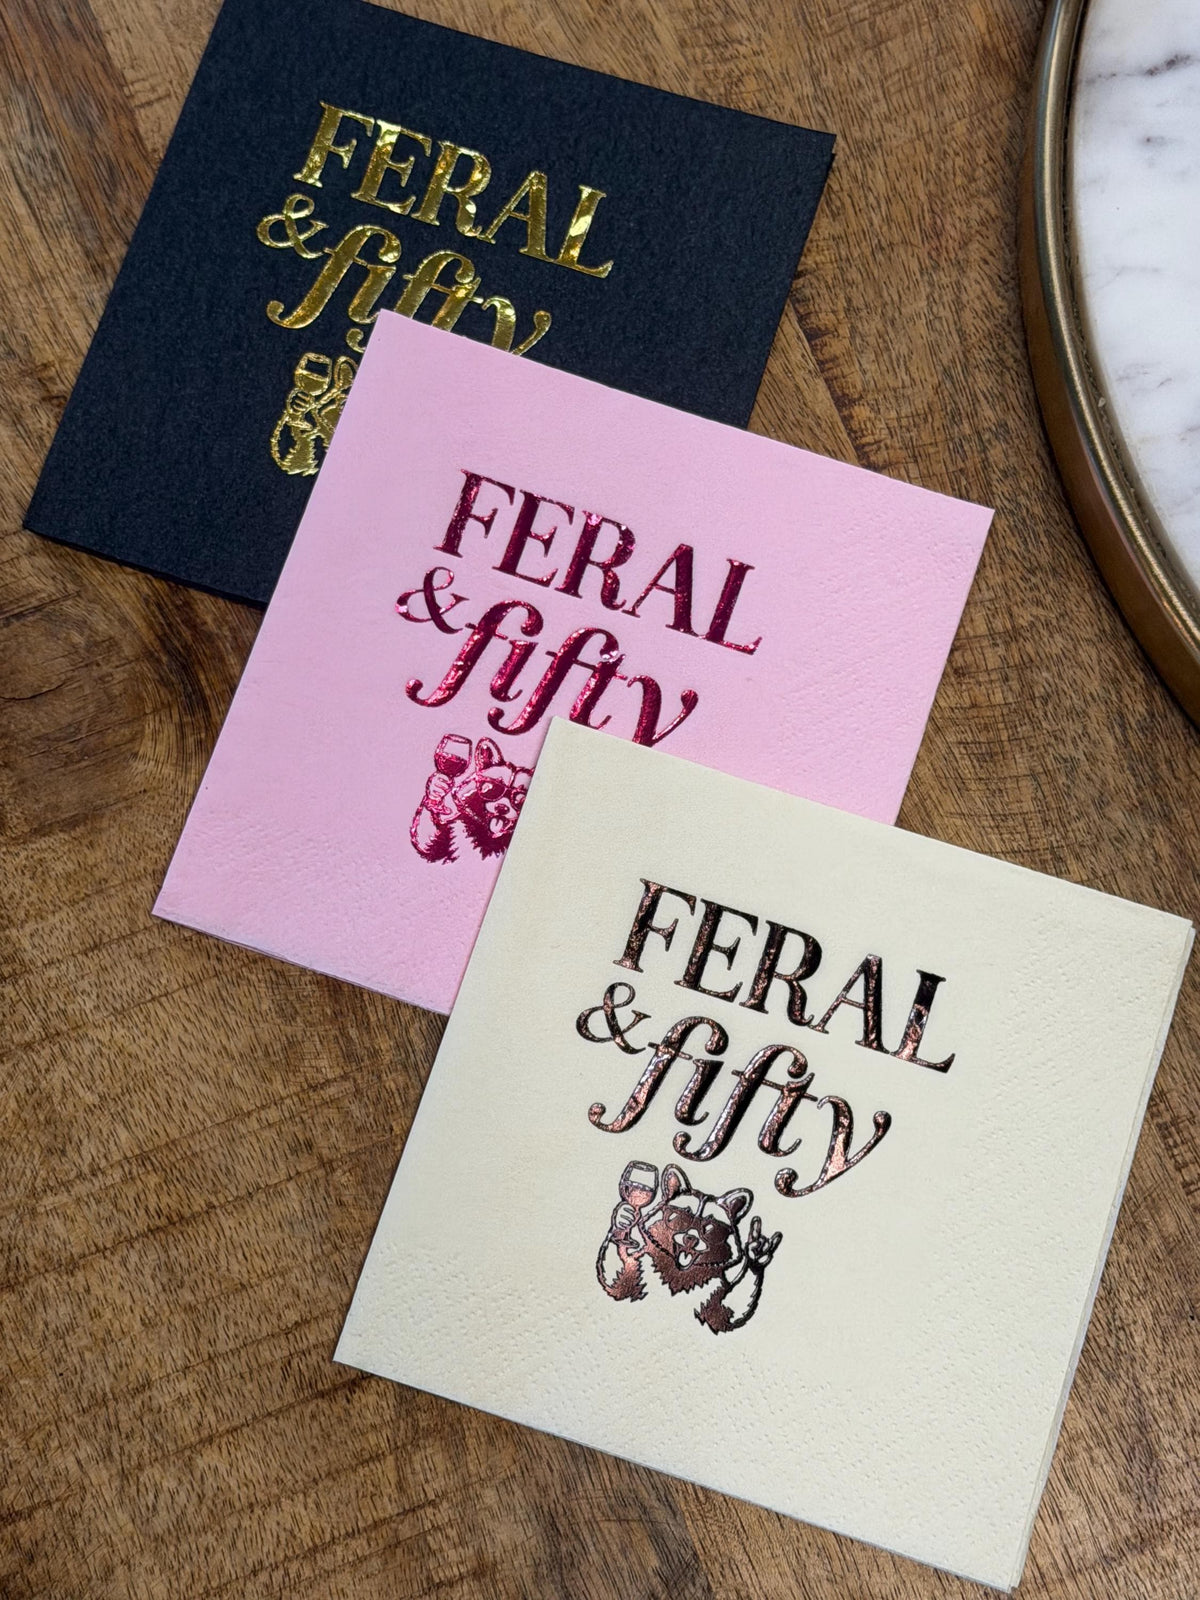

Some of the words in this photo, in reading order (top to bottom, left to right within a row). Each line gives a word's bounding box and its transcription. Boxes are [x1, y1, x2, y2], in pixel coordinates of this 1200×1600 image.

[256, 193, 329, 259] &
[293, 101, 614, 278] FERAL
[395, 566, 470, 634] &
[433, 469, 763, 655] FERAL
[405, 600, 699, 748] fifty
[576, 982, 652, 1055] &
[613, 878, 956, 1073] FERAL
[588, 1016, 892, 1198] fifty
